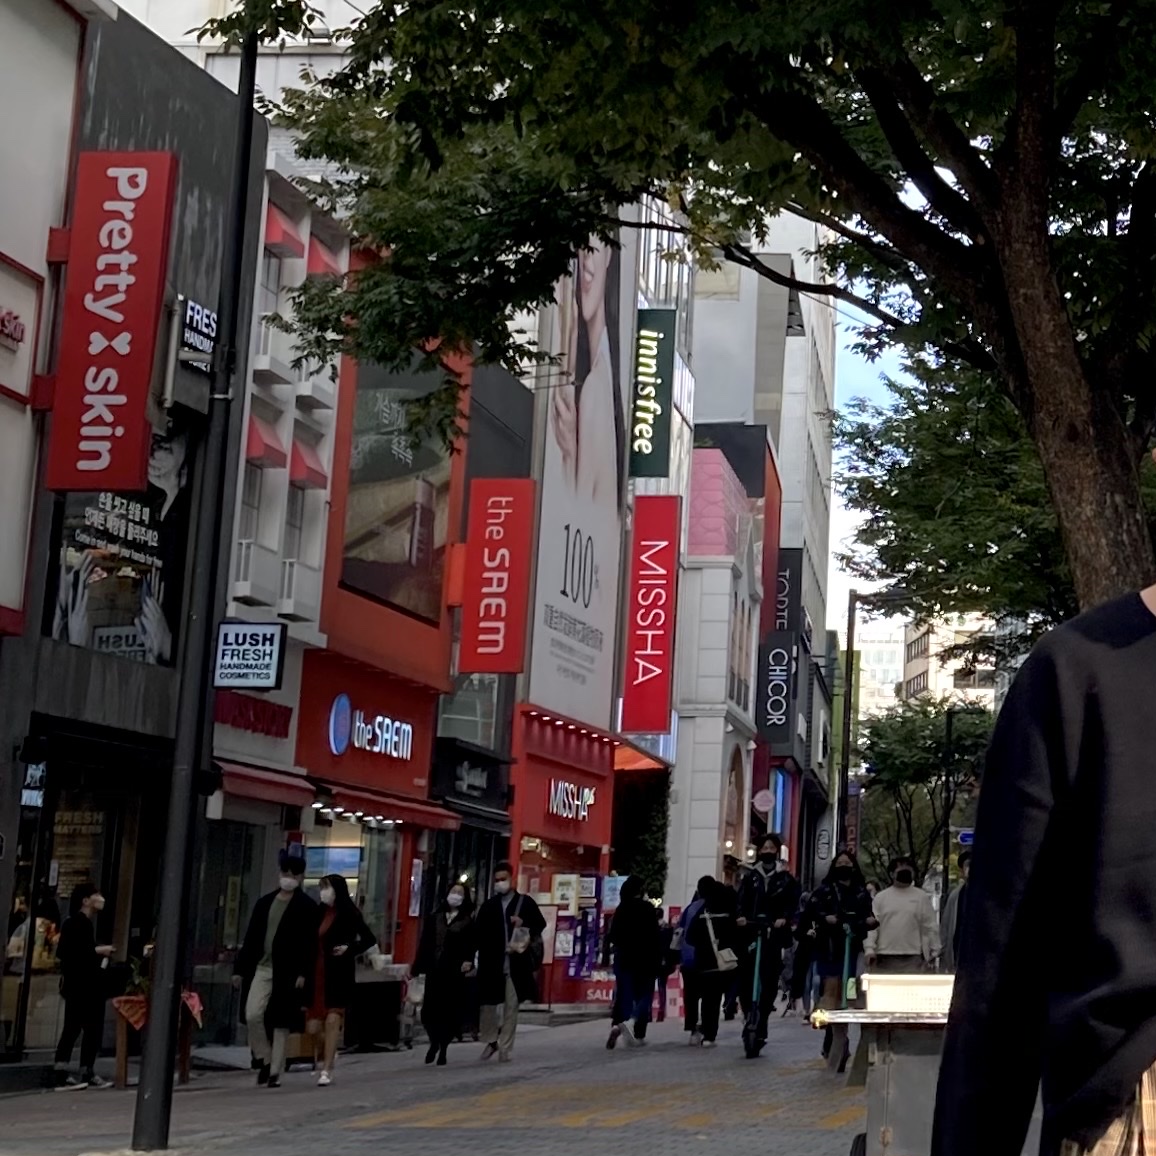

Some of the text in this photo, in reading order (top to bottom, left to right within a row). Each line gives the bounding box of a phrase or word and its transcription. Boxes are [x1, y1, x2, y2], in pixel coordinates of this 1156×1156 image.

[76, 167, 148, 470] Pretty skin
[186, 300, 218, 338] FRES
[184, 328, 214, 354] HANDMA
[633, 327, 665, 456] innisfree
[560, 523, 594, 609] 100
[633, 540, 670, 685] MISSHA
[221, 648, 273, 661] FRESH
[222, 633, 275, 647] LUSH
[219, 662, 272, 671] HANDMADE
[219, 671, 271, 680] COSMETICS
[766, 648, 789, 727] CHICOR
[549, 777, 589, 823] MISSHA
